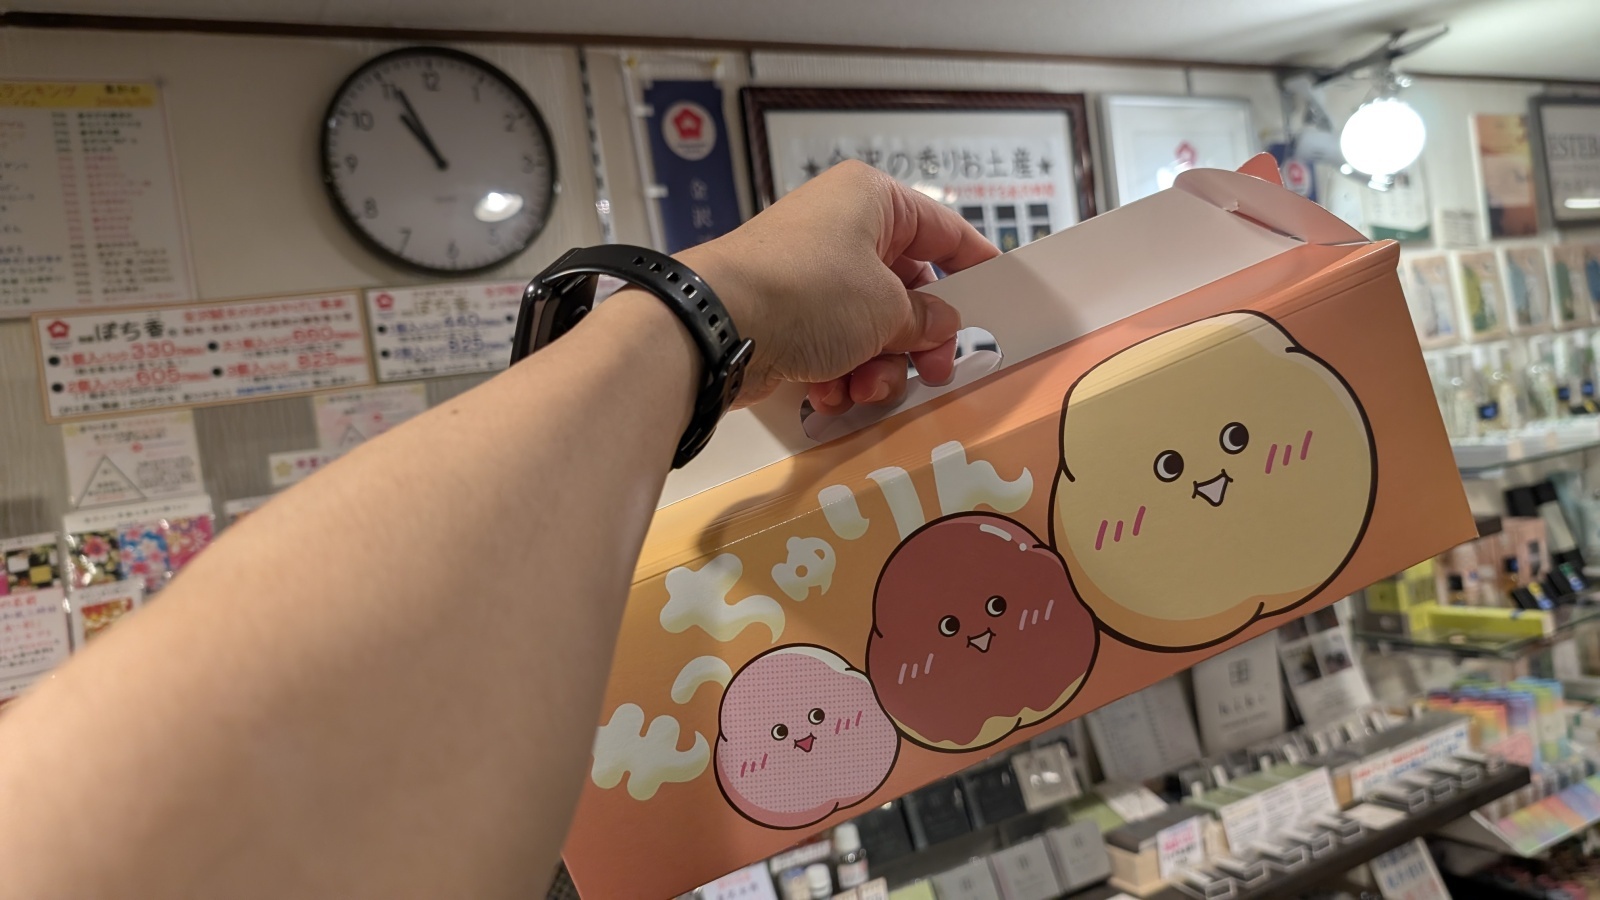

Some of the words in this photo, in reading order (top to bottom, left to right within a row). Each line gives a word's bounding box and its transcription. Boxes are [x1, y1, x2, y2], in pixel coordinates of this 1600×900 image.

[421, 70, 440, 92] 12
[471, 84, 480, 104] 1
[352, 110, 375, 132] 10
[503, 112, 517, 133] 2
[344, 154, 359, 174] 9
[522, 153, 536, 175] 3
[363, 197, 379, 220] 8
[690, 170, 715, 240] 金沢
[400, 227, 412, 252] 7
[446, 241, 460, 260] 6
